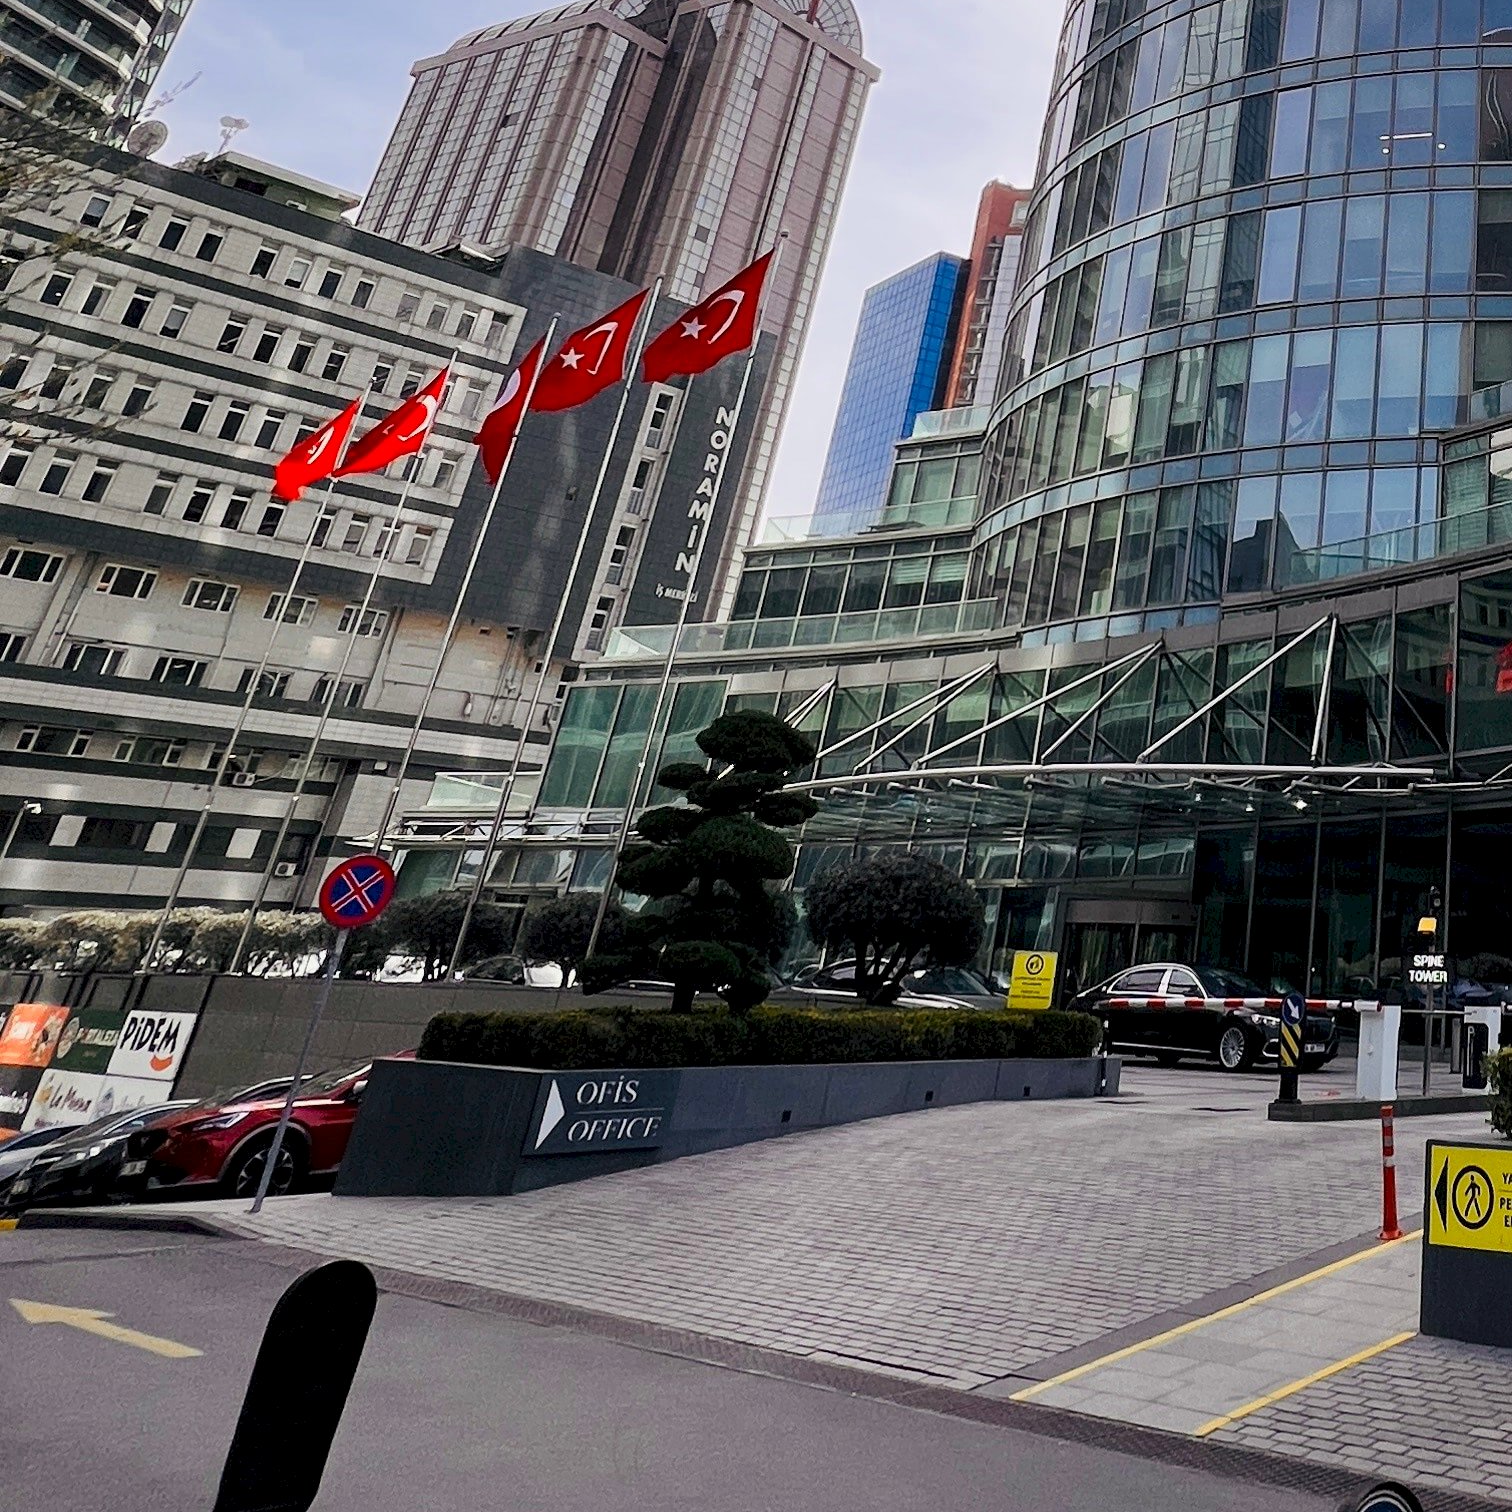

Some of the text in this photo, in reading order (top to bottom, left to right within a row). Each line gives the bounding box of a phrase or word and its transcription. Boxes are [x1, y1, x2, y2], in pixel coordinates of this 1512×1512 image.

[674, 405, 735, 574] NORAMİN
[1413, 954, 1445, 968] SPINE
[1408, 969, 1448, 983] TOWER
[119, 1016, 183, 1055] PİDEM
[576, 1074, 640, 1104] OFİS
[567, 1116, 663, 1142] OFFICE
